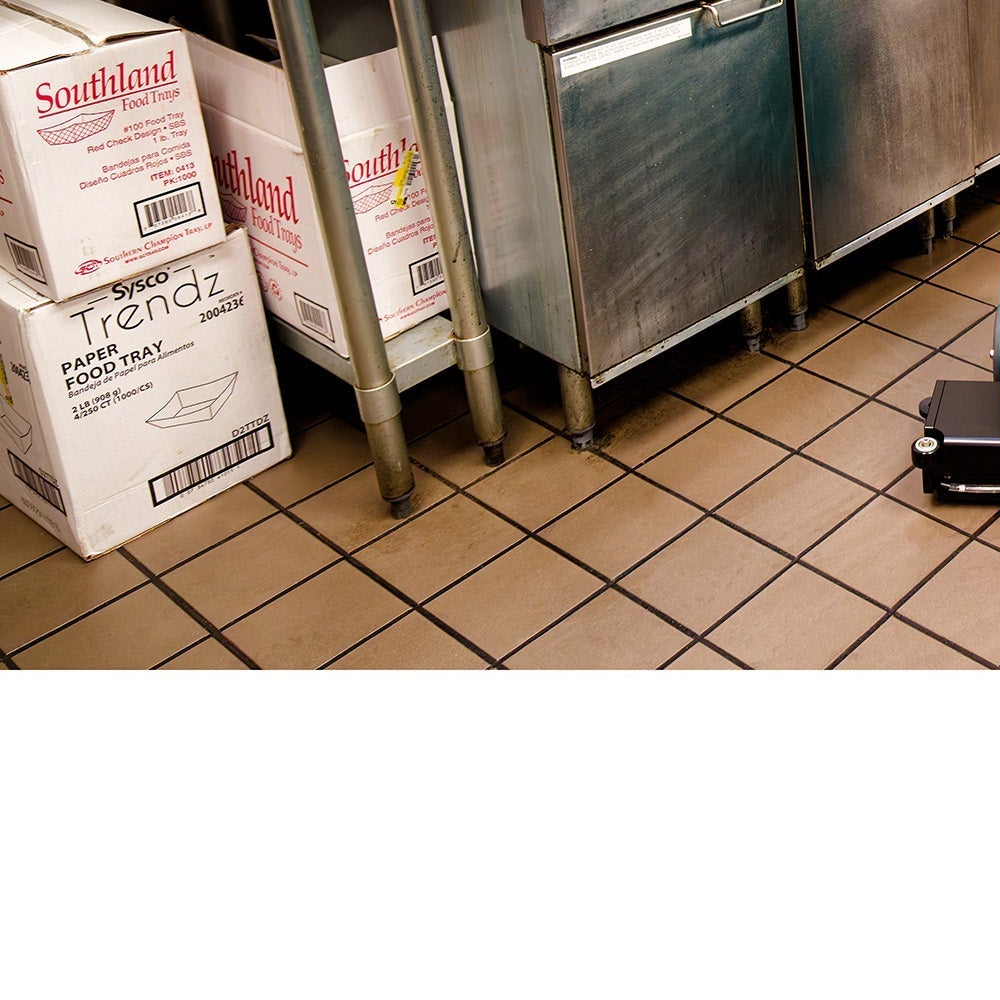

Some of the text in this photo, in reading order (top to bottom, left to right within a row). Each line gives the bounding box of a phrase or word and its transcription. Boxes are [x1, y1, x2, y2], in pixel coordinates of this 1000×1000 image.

[35, 50, 178, 114] Southland
[121, 88, 181, 112] Food Trays
[145, 116, 166, 127] Food
[167, 111, 184, 121] Tray
[171, 129, 188, 139] Tray
[87, 119, 186, 154] Red Check Design SBS
[79, 149, 193, 190] Diseño Cuadros Rojos SBS
[102, 141, 191, 174] Bandejas para Comida
[150, 162, 195, 182] ITEM: 0413
[163, 171, 198, 187] PK:1000
[213, 150, 299, 225] uthland
[250, 206, 303, 254] Food Trays
[375, 211, 389, 222] Red
[385, 222, 416, 239] Bandejas
[367, 224, 435, 255] Diseño Cuadros Rojo
[111, 271, 169, 301] Sysco
[70, 269, 225, 345] Trendz
[61, 343, 119, 375] PAPER
[65, 340, 163, 390] FOOD TRAY
[68, 341, 195, 399] Bandeja de Papel para Alimentos
[74, 382, 153, 420] 4/250 CT (1000/CS)
[79, 401, 91, 410] LB
[92, 392, 111, 405] (908
[112, 387, 121, 397] g)
